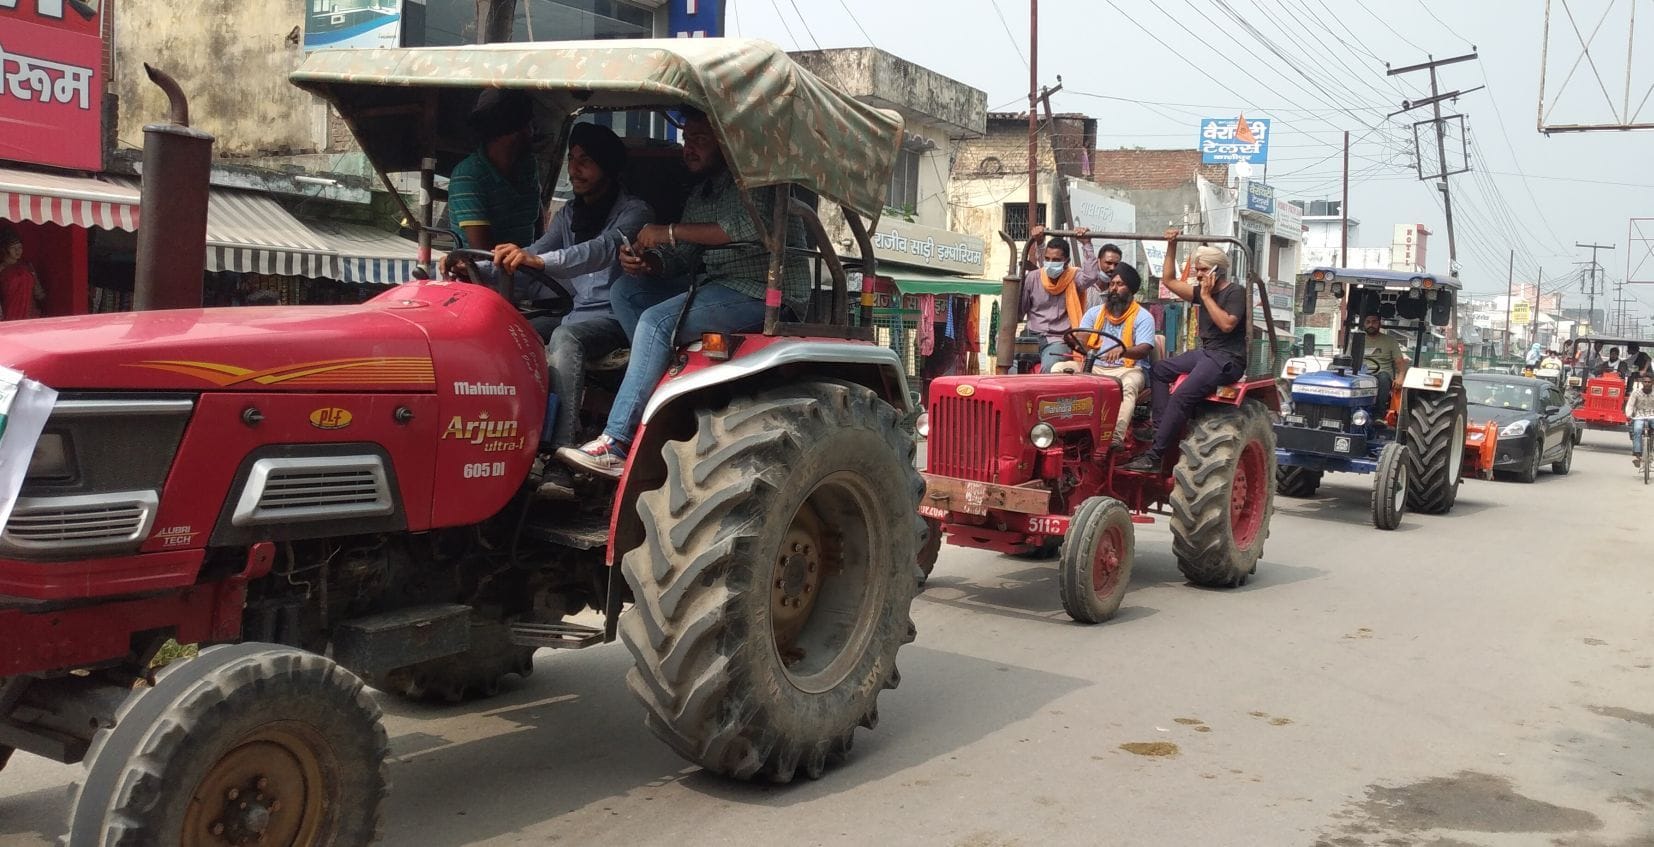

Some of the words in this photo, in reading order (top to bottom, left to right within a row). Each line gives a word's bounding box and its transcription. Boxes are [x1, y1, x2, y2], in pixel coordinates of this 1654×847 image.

[0, 44, 93, 109] रूम
[875, 230, 907, 253] राजीव
[909, 237, 935, 264] साड़ी
[454, 381, 516, 396] Mahindra
[441, 409, 518, 445] Arjun
[463, 462, 491, 479] 605
[492, 461, 505, 477] DI
[161, 525, 191, 535] LUBRI
[164, 535, 191, 545] TECH
